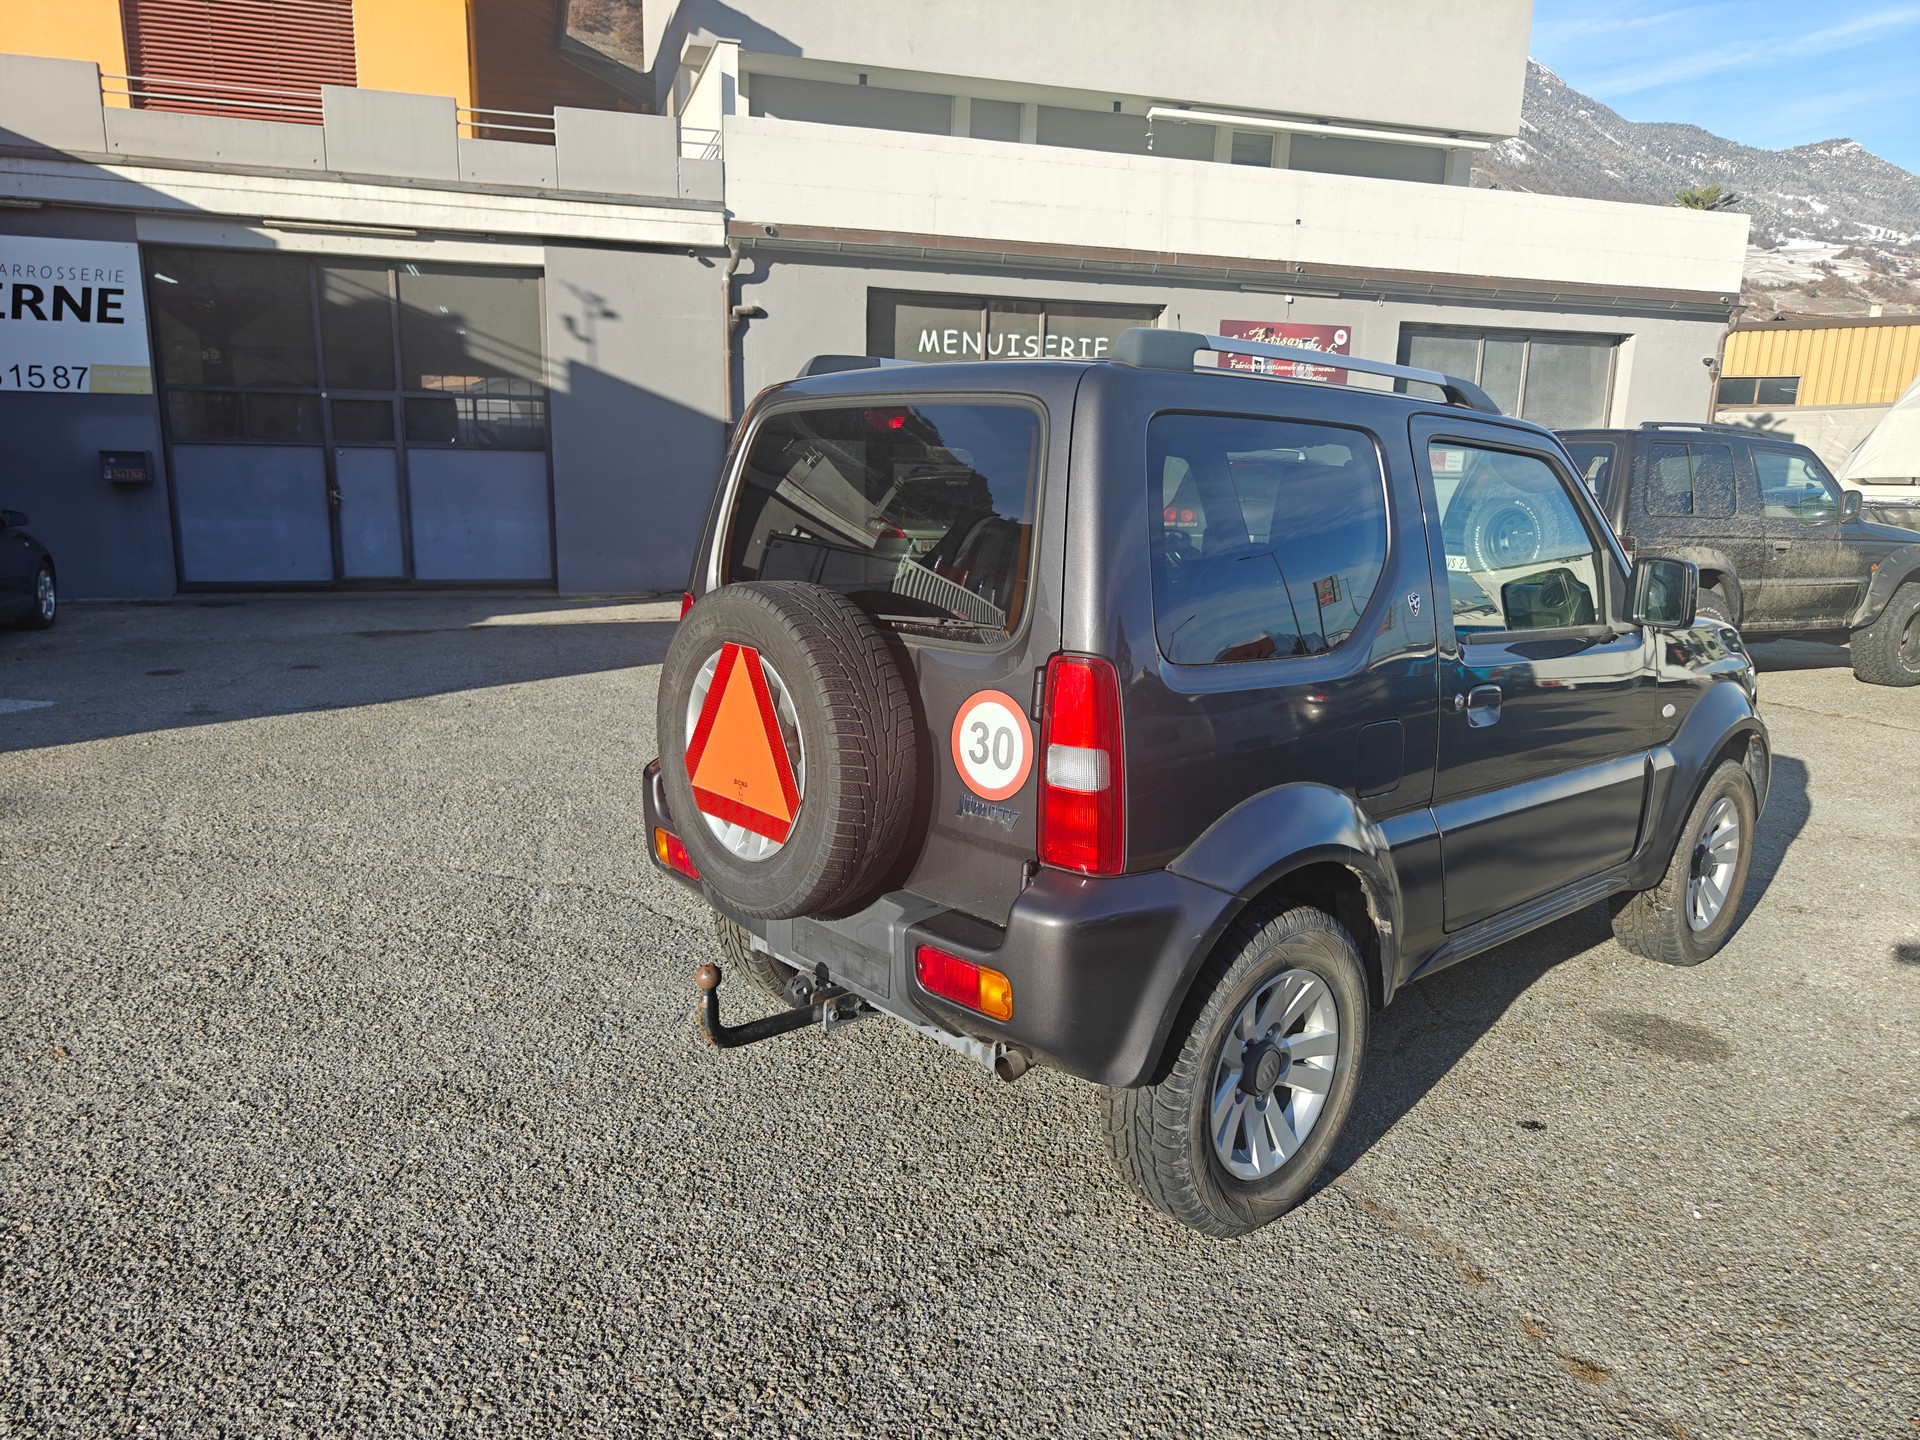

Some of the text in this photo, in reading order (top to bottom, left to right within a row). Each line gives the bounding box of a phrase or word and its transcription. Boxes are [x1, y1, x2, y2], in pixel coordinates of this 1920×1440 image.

[0, 282, 125, 324] RNE
[918, 329, 1109, 357] MENUISERIE
[968, 721, 1015, 771] 30
